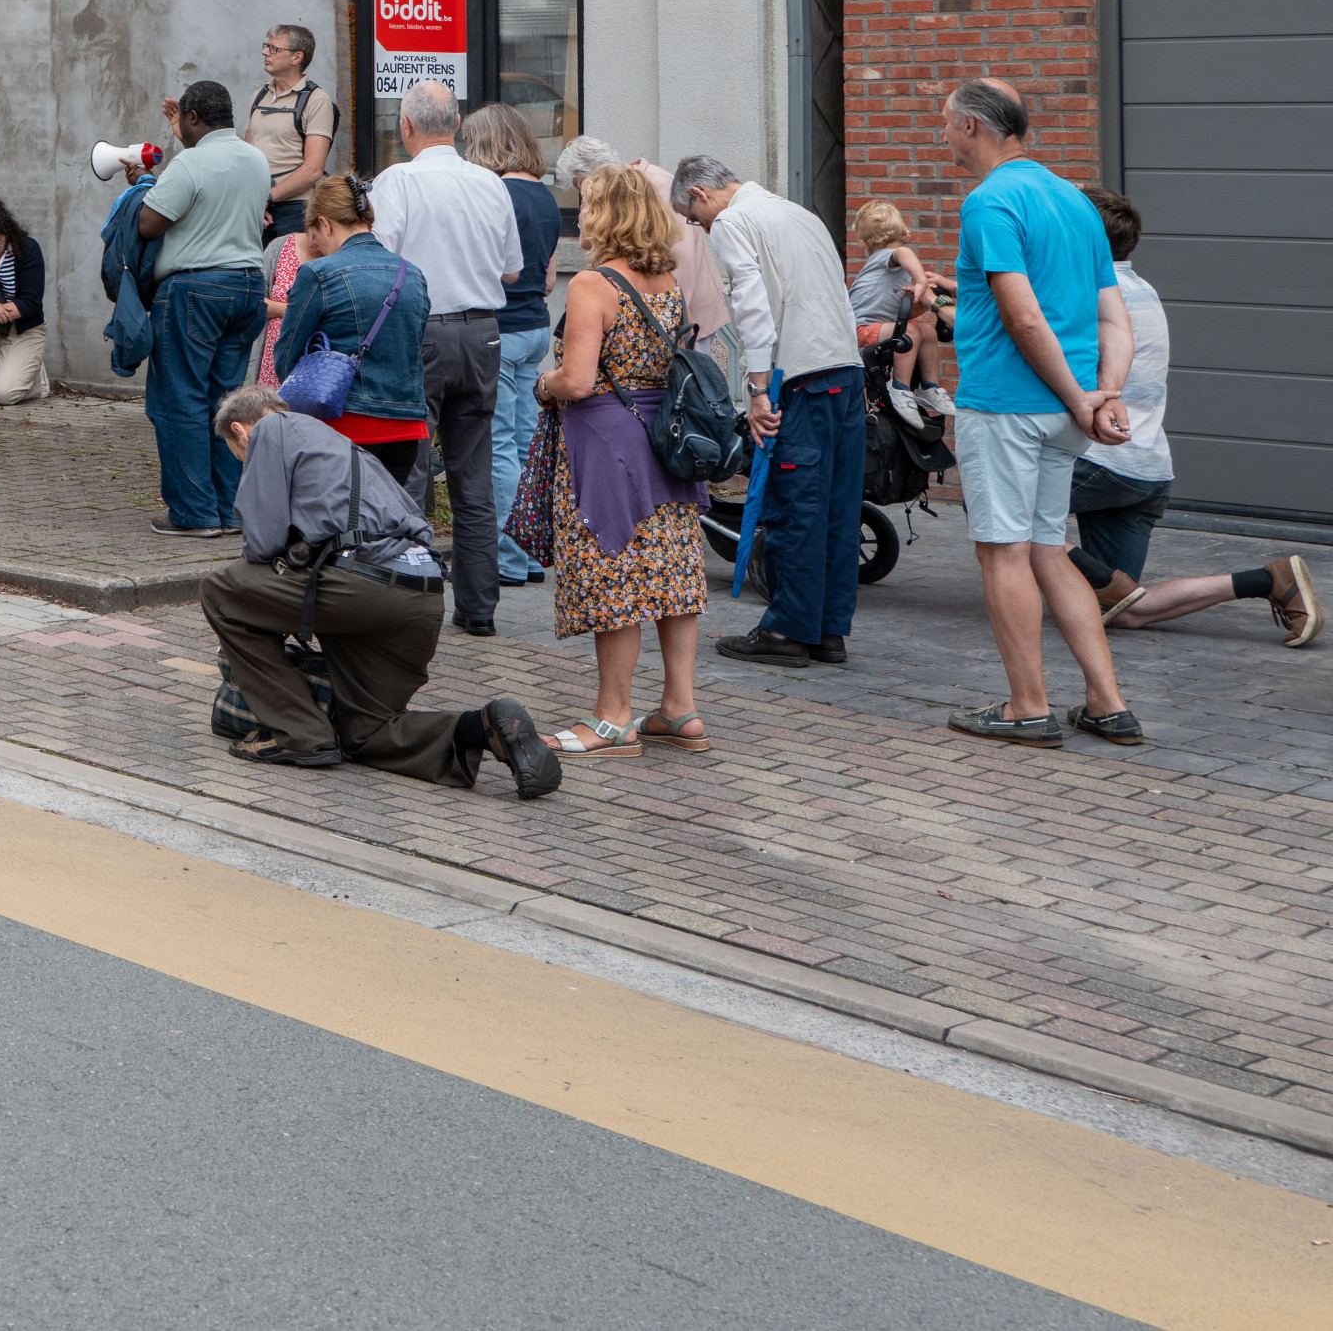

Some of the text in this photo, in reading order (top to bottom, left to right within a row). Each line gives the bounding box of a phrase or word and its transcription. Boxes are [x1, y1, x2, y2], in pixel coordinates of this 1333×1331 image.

[376, 63, 455, 75] LAURENT RENS
[376, 76, 397, 92] 054
